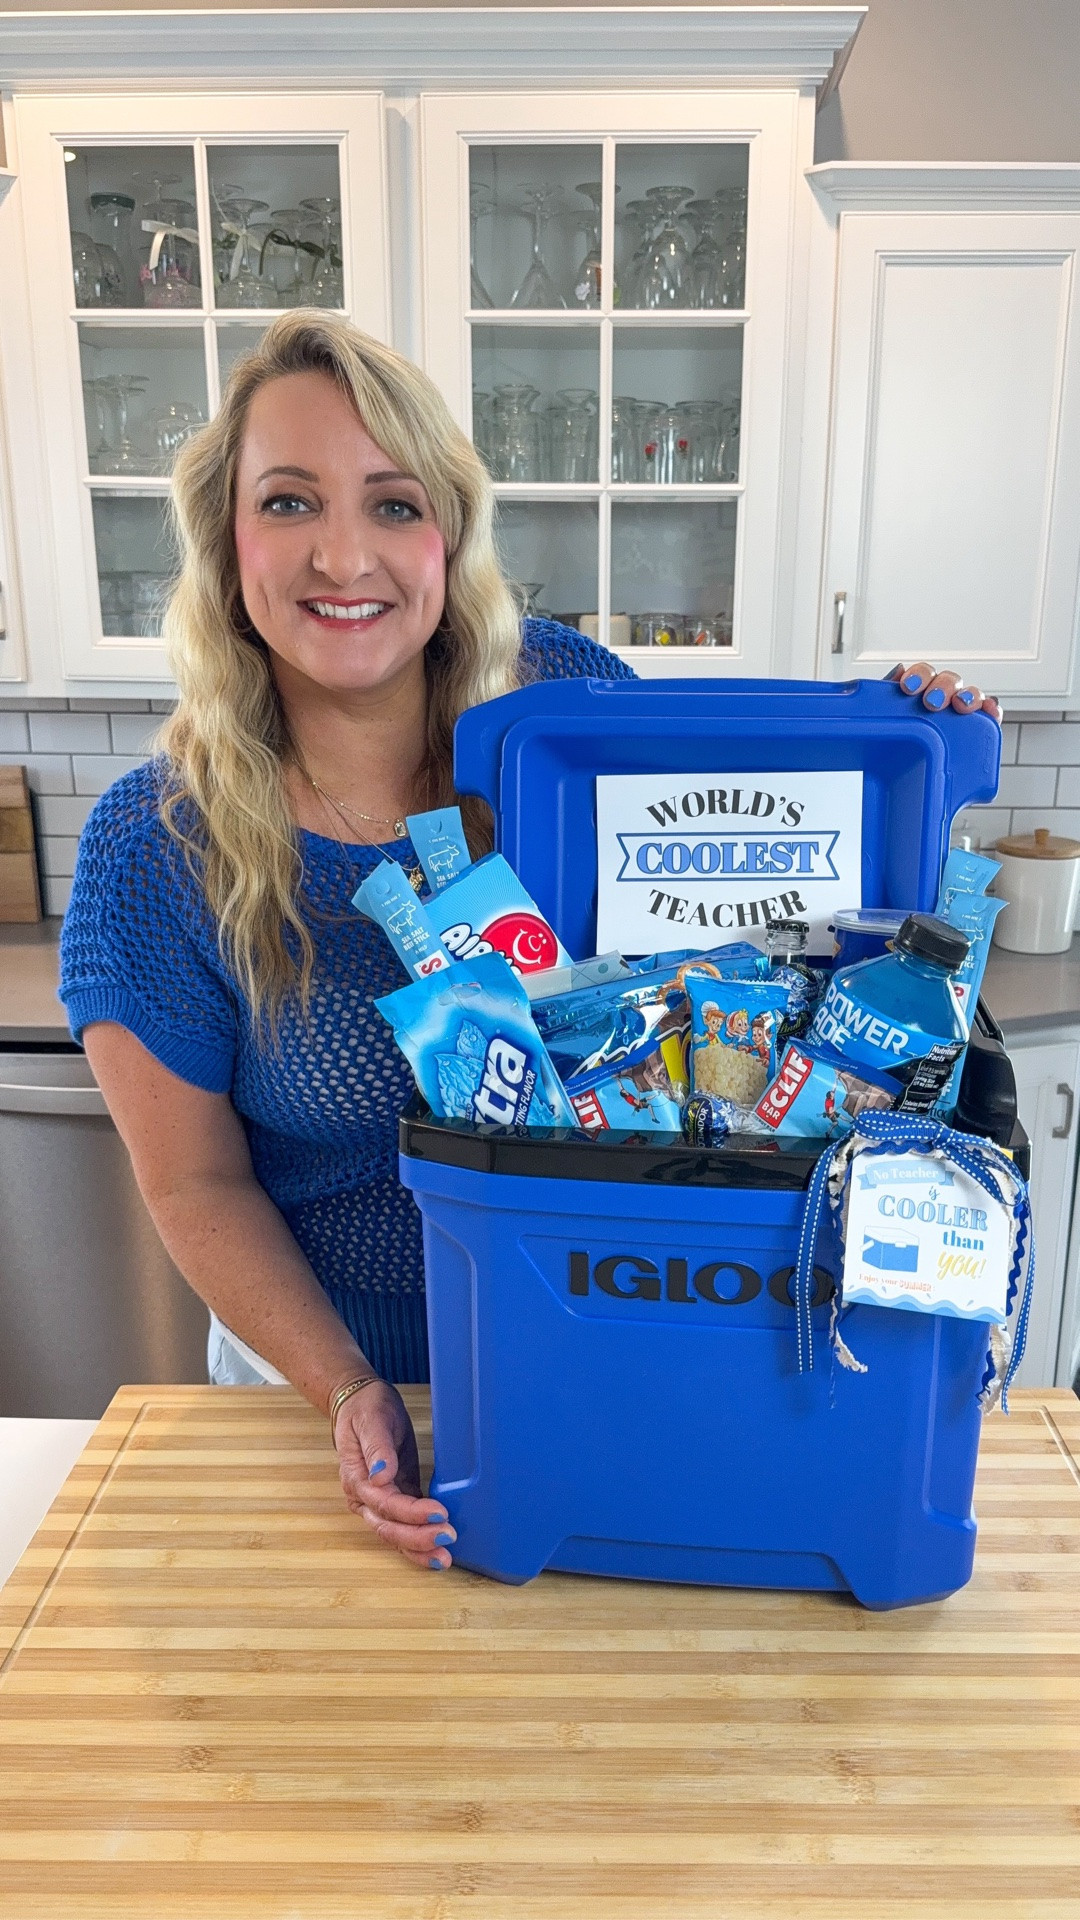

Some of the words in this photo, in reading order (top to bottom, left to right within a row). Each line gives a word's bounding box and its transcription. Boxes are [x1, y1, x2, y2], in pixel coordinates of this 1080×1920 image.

[645, 788, 805, 827] WORLD'S
[636, 841, 820, 875] COOLEST
[647, 889, 808, 928] TEACHER
[410, 926, 425, 938] SALT
[412, 931, 431, 946] STICK
[813, 1006, 852, 1052] ADE
[825, 982, 909, 1056] POWER
[927, 1053, 946, 1062] Facts
[931, 1045, 957, 1056] Nutrition
[520, 1069, 537, 1102] FLAVOR
[769, 1051, 808, 1109] CLIF
[573, 1095, 602, 1129] LIF
[761, 1101, 781, 1120] BAR
[873, 1169, 888, 1180] No
[890, 1167, 939, 1180] Teacher
[928, 1185, 940, 1200] is
[878, 1194, 988, 1231] COOLER
[943, 1230, 984, 1251] than
[569, 1251, 835, 1308] IGLOO
[858, 1273, 878, 1284] Enjoy
